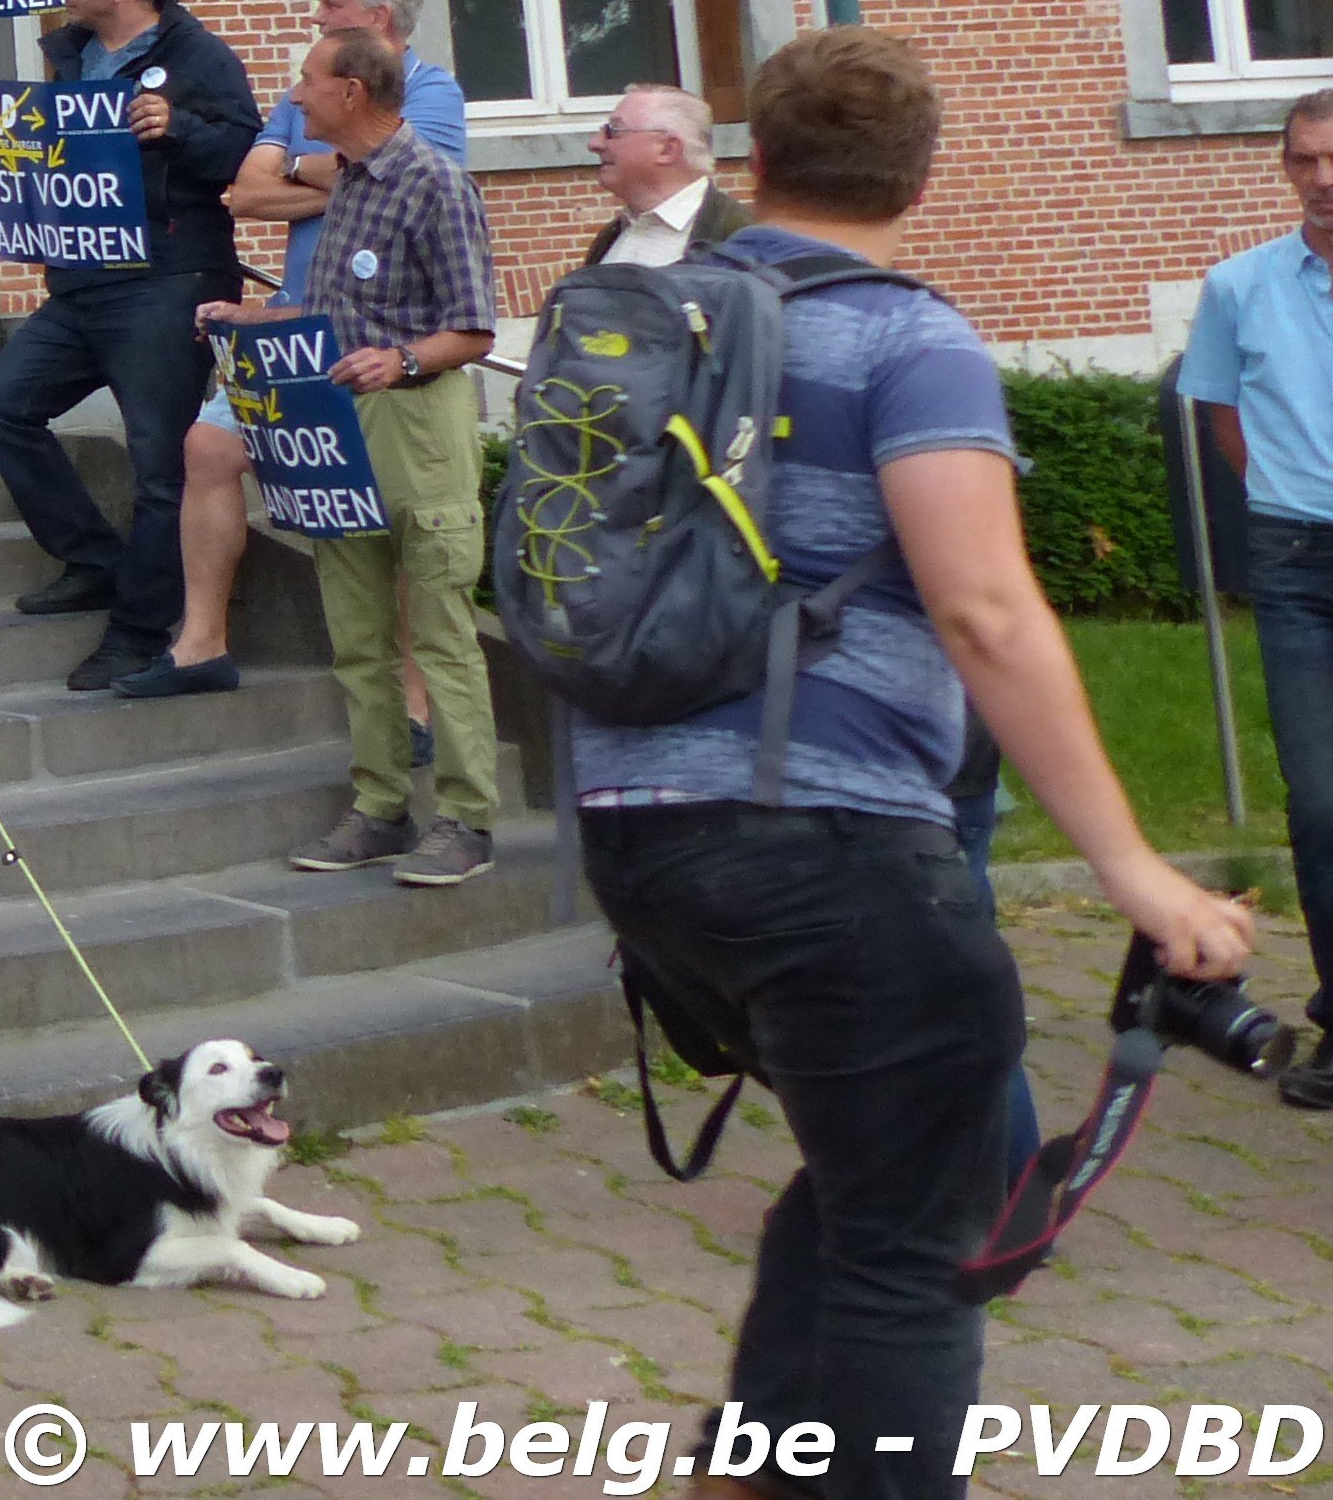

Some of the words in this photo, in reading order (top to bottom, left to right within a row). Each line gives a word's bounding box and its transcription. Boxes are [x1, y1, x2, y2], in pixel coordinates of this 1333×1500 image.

[55, 92, 125, 129] PVV
[32, 171, 124, 207] VOOR
[256, 330, 324, 377] PVV
[262, 425, 347, 467] VOOR
